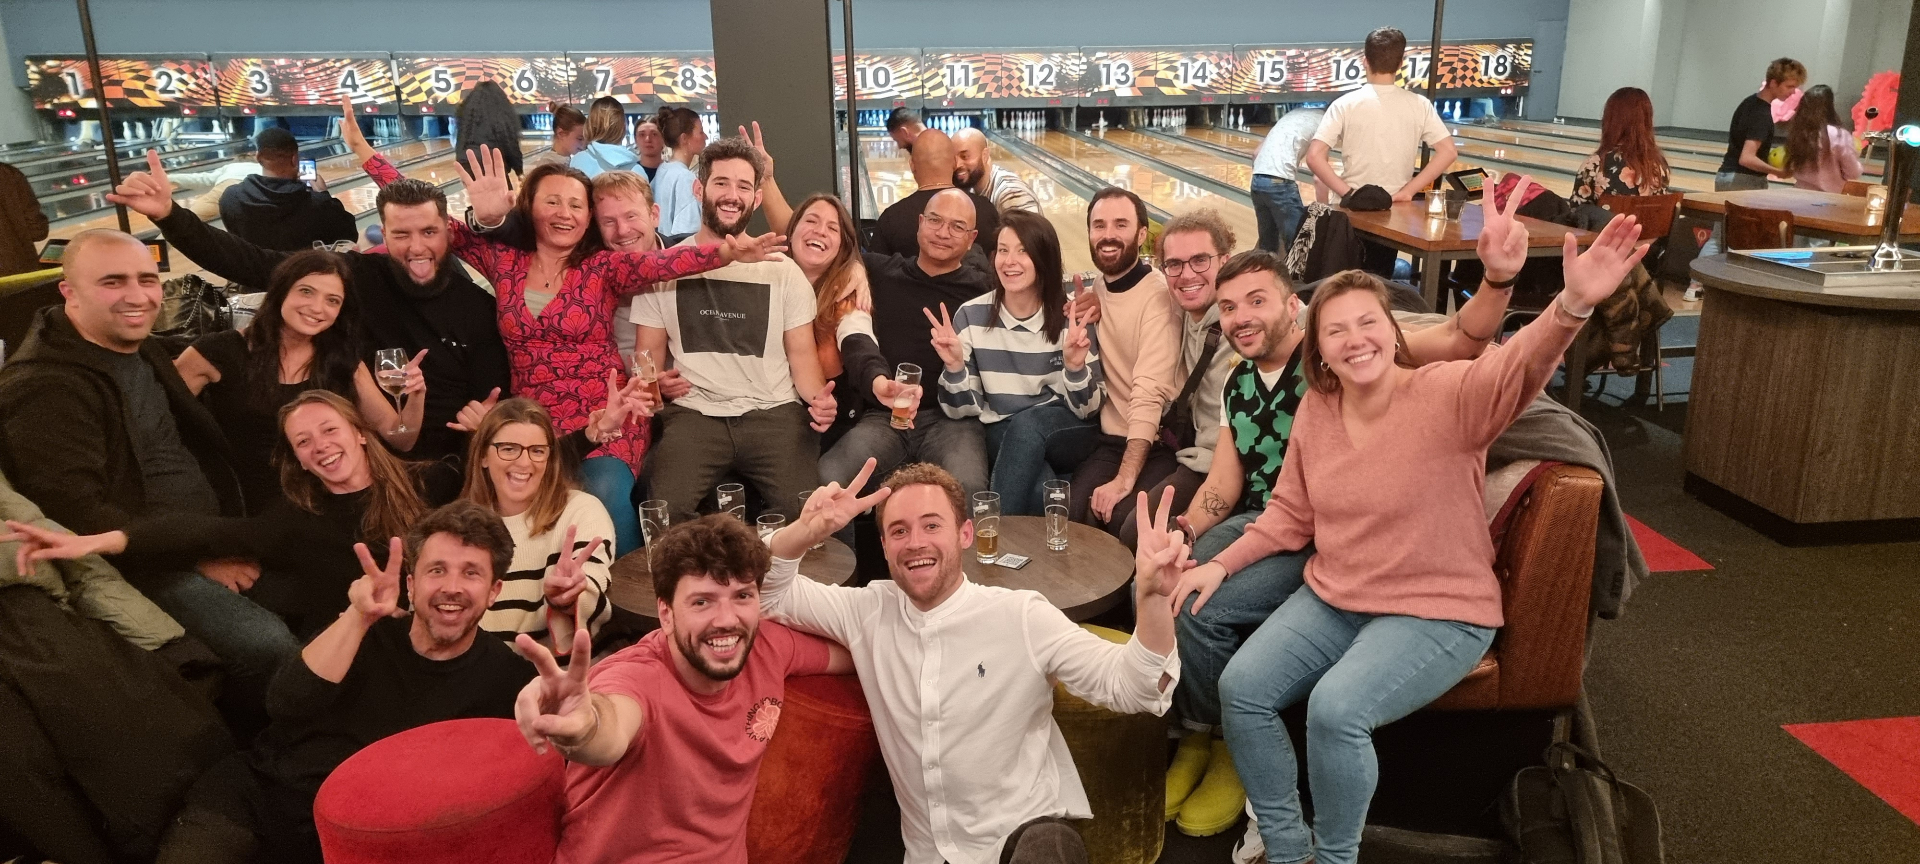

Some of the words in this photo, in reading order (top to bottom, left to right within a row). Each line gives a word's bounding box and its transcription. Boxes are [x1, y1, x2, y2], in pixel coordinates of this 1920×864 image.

[947, 65, 969, 87] 11
[1025, 64, 1053, 86] 12
[1102, 63, 1130, 85] 13
[1181, 62, 1208, 84] 14
[1257, 60, 1284, 82] 15
[1333, 59, 1360, 80] 16
[1409, 58, 1431, 79] 17
[1482, 55, 1508, 77] 18
[66, 72, 80, 95] 1
[156, 71, 175, 94] 2
[250, 70, 268, 93] 3
[341, 70, 359, 92] 4
[433, 70, 452, 92] 5
[516, 70, 533, 92] 6
[596, 69, 610, 91] 7
[681, 68, 697, 91] 8
[856, 67, 890, 88] 10
